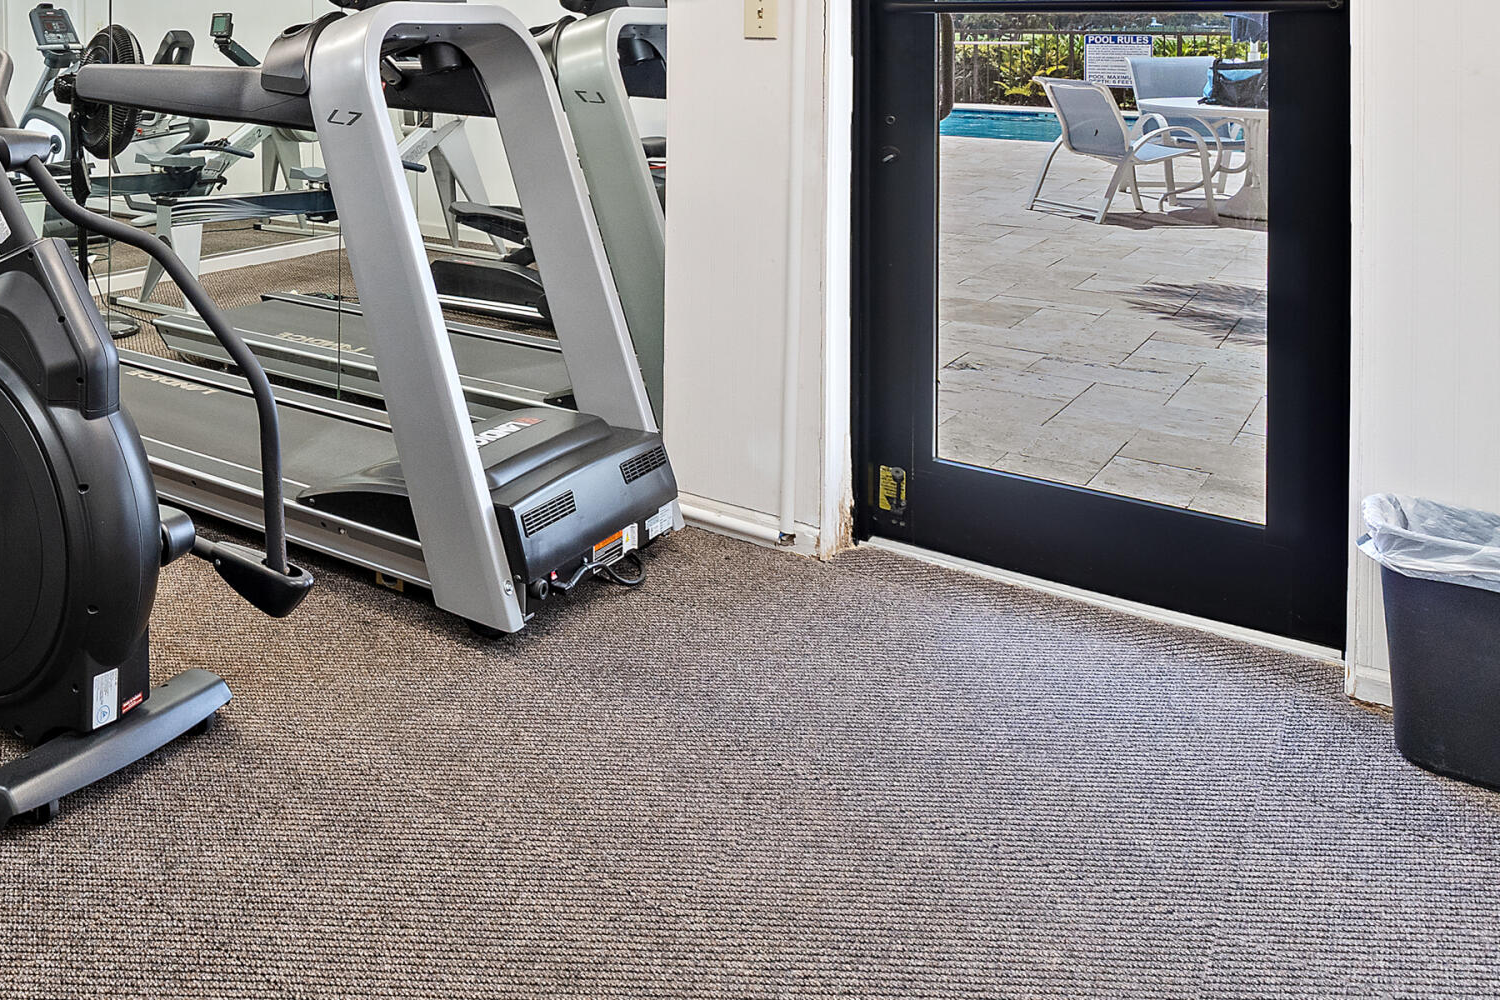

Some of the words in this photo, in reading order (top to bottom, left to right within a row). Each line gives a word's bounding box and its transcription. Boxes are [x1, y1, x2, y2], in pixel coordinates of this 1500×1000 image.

[1088, 36, 1115, 44] POOL
[1117, 36, 1149, 44] RULES
[326, 109, 363, 126] L7
[124, 369, 220, 395] LANDICE
[474, 420, 534, 450] LANDIC
